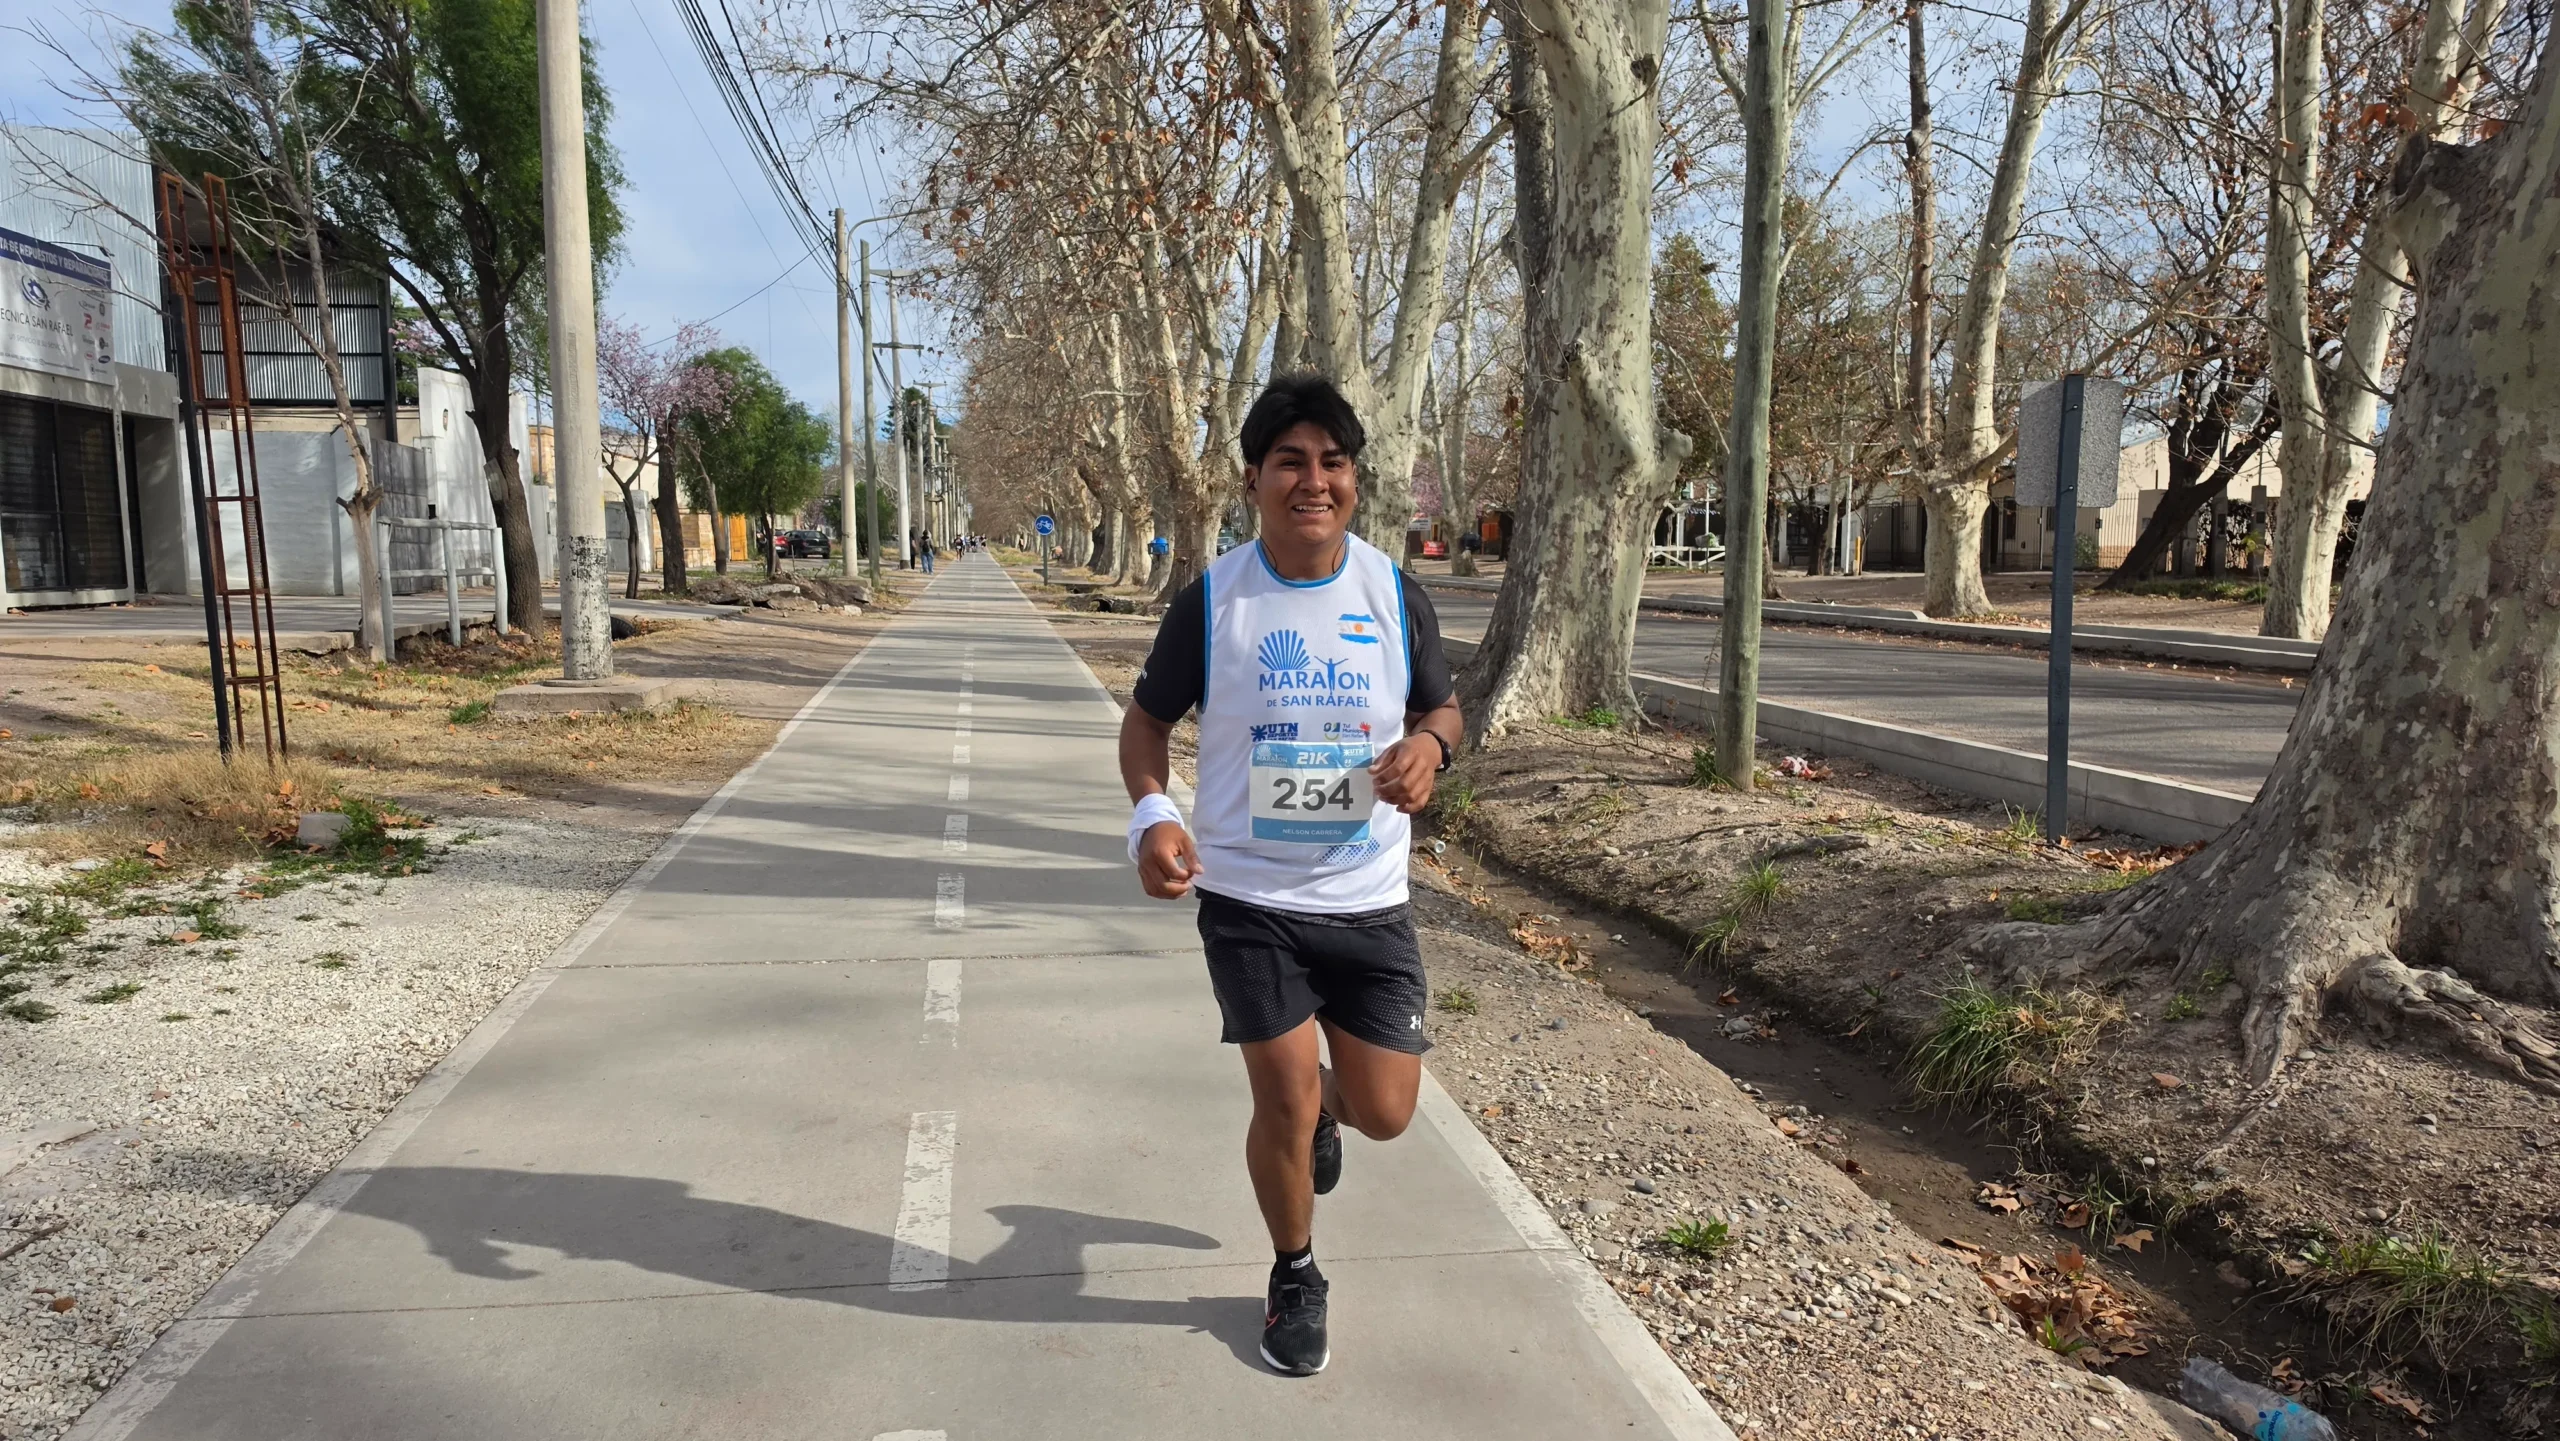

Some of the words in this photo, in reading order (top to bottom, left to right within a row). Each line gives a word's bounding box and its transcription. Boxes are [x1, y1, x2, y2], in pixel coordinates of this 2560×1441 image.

[19, 242, 58, 266] REPUESTOS
[58, 256, 64, 267] Y
[0, 307, 30, 326] ECNICA
[32, 315, 47, 330] SAN
[49, 319, 73, 337] RAFAEL
[1259, 664, 1370, 694] MARATON
[1266, 699, 1277, 708] DE
[1281, 695, 1312, 707] SAN
[1315, 695, 1370, 708] RAFAEL
[1267, 722, 1299, 734] UTN
[1296, 751, 1331, 765] 21K
[1272, 777, 1354, 811] 254
[1282, 828, 1310, 836] NELSON
